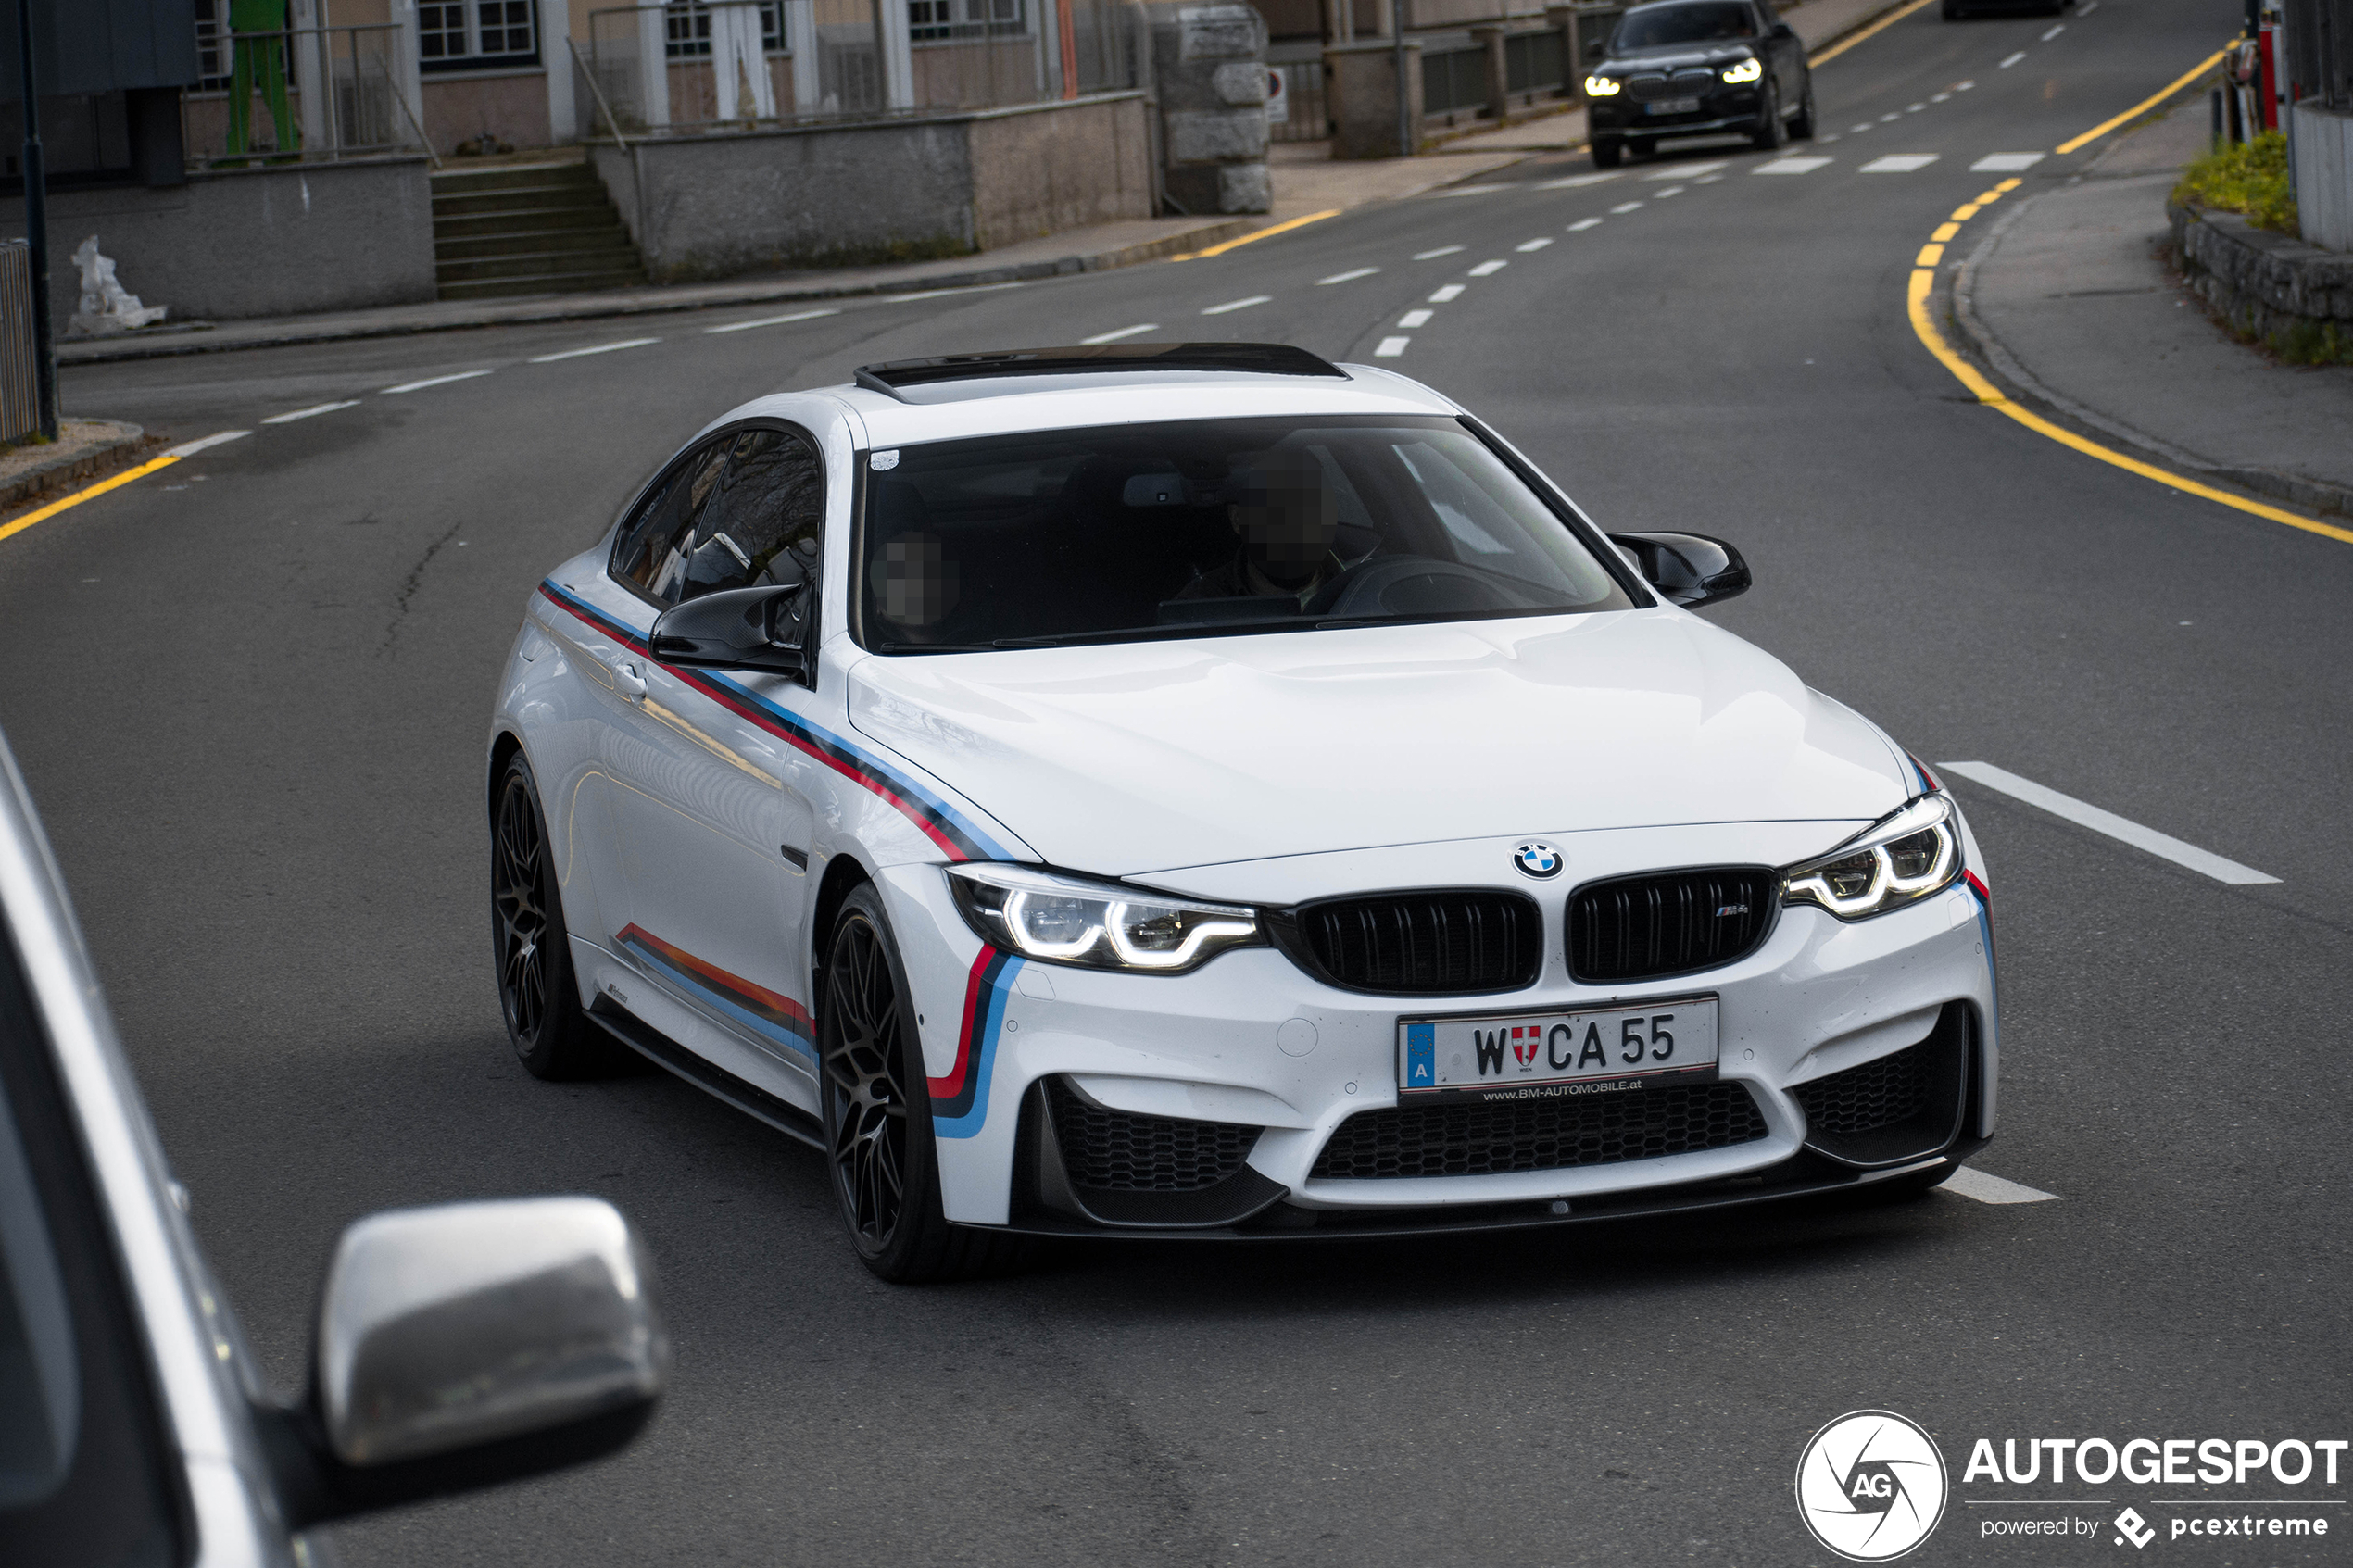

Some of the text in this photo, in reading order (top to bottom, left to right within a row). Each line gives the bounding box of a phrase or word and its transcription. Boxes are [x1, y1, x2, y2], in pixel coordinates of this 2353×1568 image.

[1474, 1028, 1507, 1074] W
[1621, 1014, 1674, 1063] 55
[1415, 1064, 1428, 1078] A
[1483, 1080, 1642, 1100] www.BM-AUTOMOBILE.at
